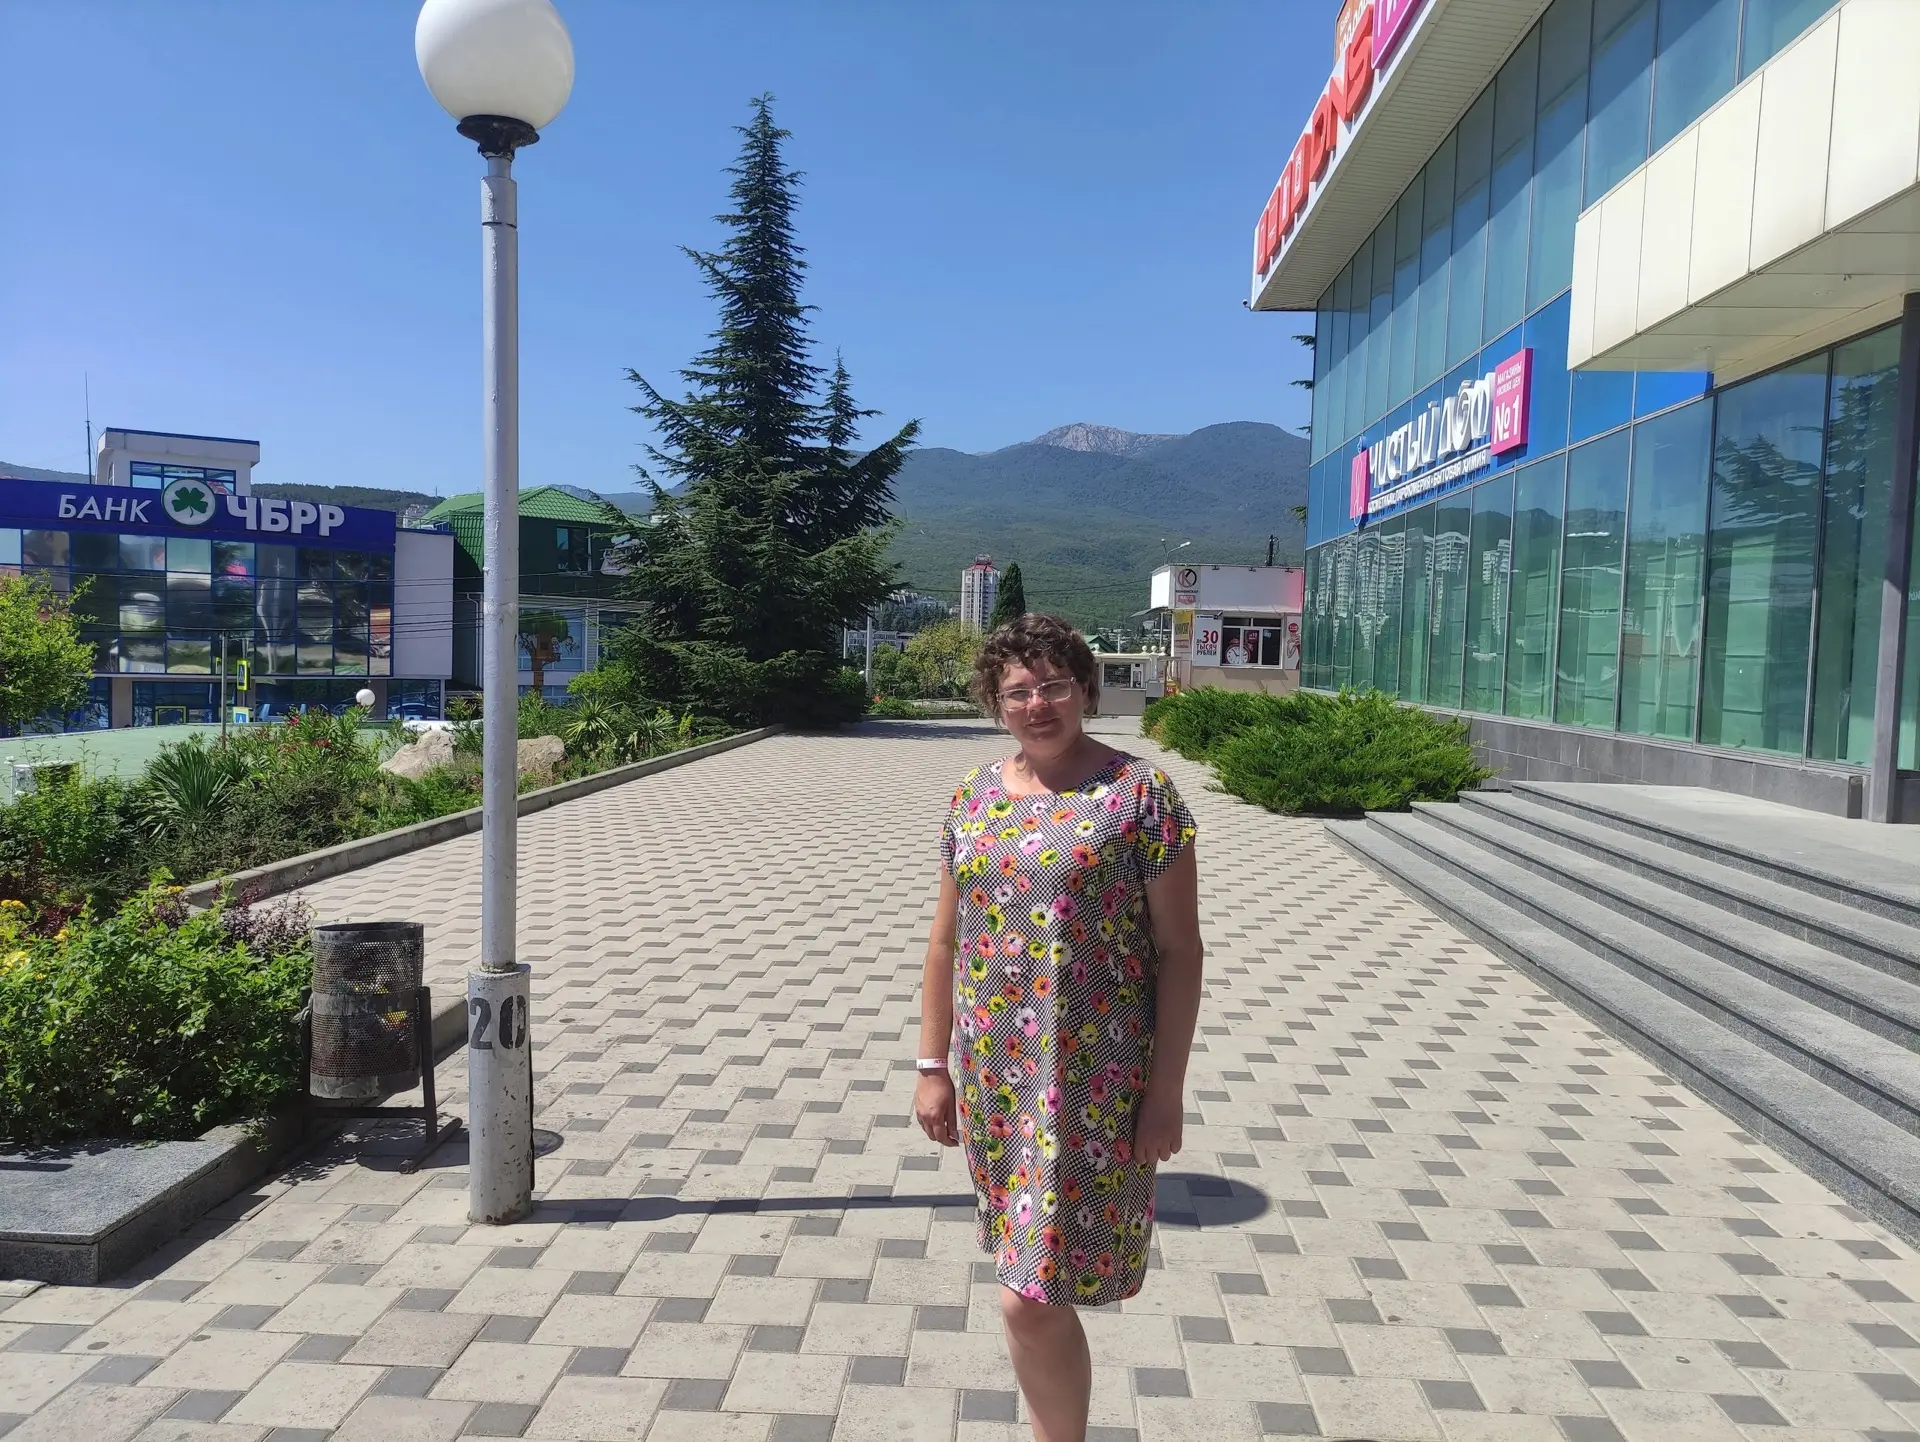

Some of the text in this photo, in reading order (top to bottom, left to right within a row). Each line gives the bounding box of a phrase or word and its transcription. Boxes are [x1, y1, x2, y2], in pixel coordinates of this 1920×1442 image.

[1309, 4, 1373, 183] DNS
[58, 494, 345, 537] БАНК ЧБРР
[1196, 643, 1217, 651] ТЫСЯЧ
[1202, 629, 1219, 644] 30
[469, 995, 527, 1050] 20
